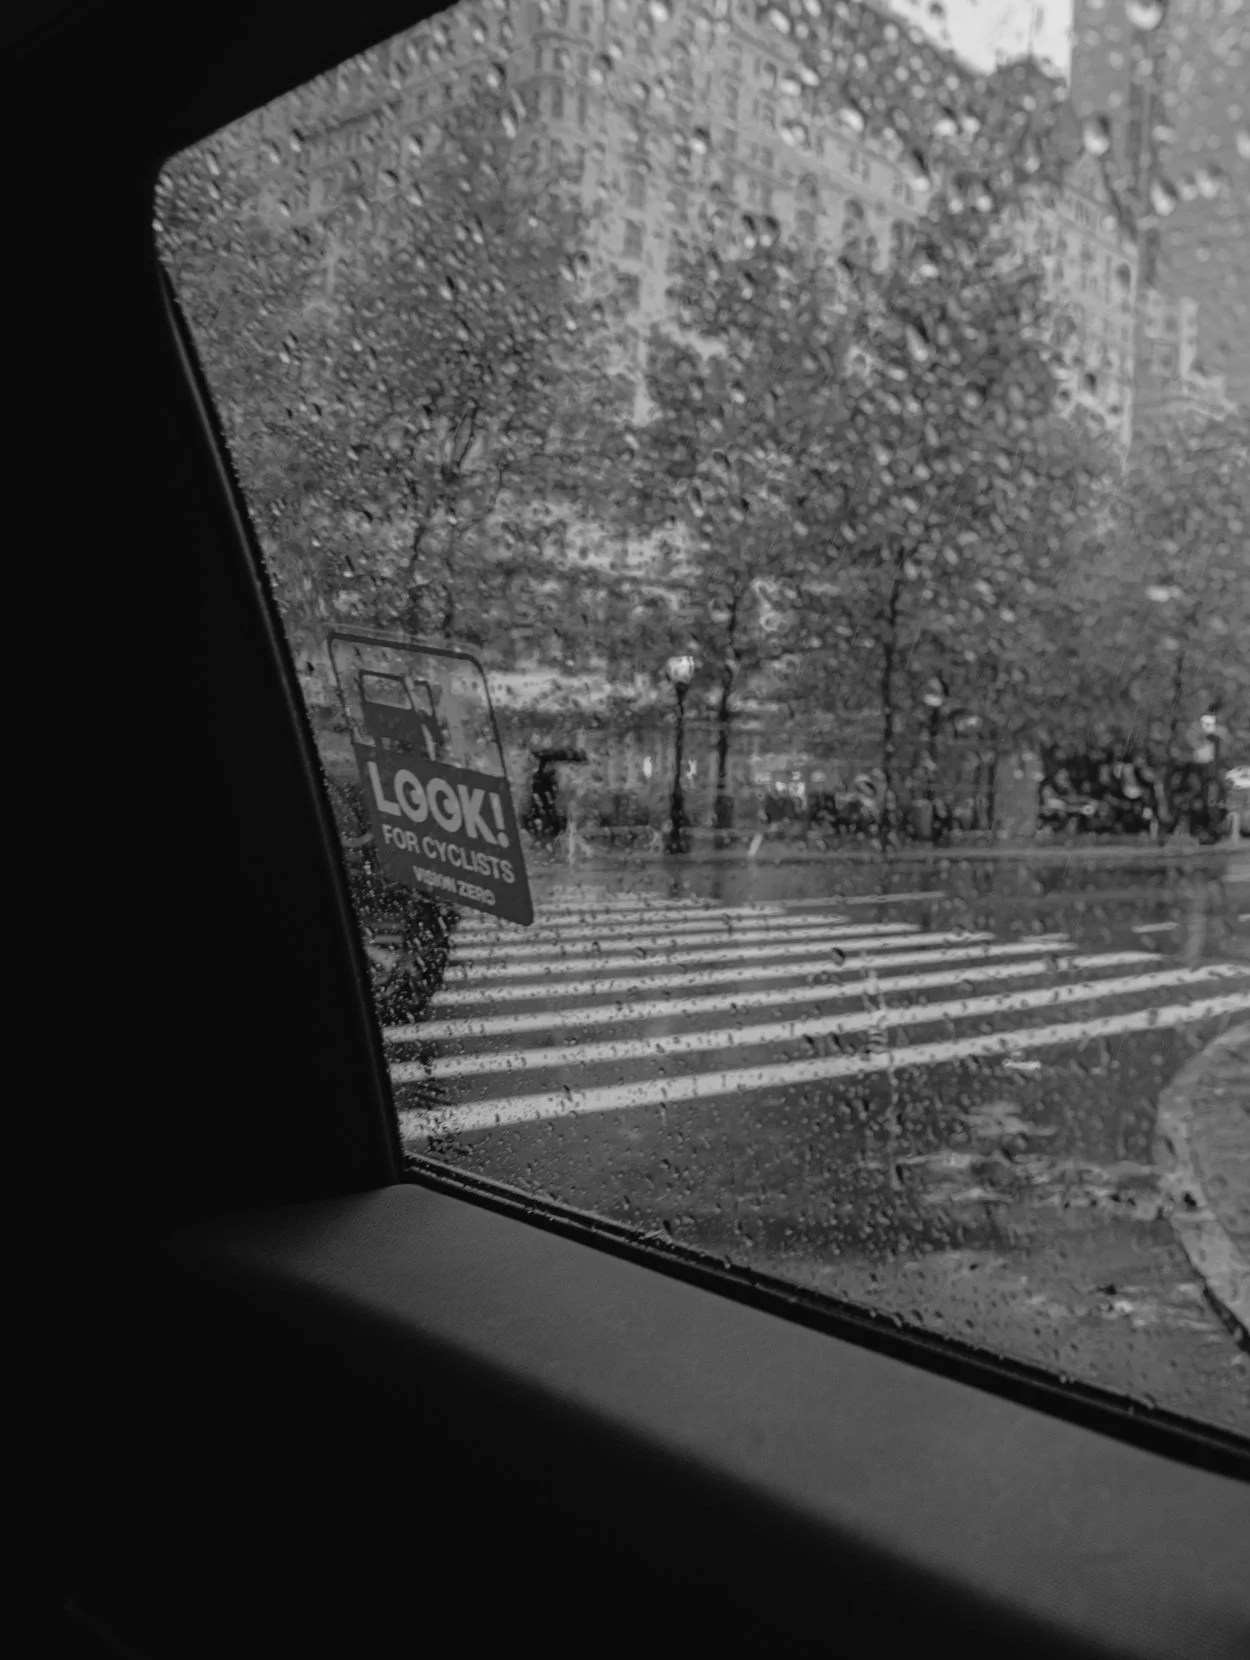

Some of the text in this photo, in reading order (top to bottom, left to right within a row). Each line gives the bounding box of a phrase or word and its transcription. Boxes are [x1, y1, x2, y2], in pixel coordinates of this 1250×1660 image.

[367, 761, 509, 848] LOOK!
[382, 824, 515, 884] FOR CYCLISTS
[457, 880, 496, 906] ZERO
